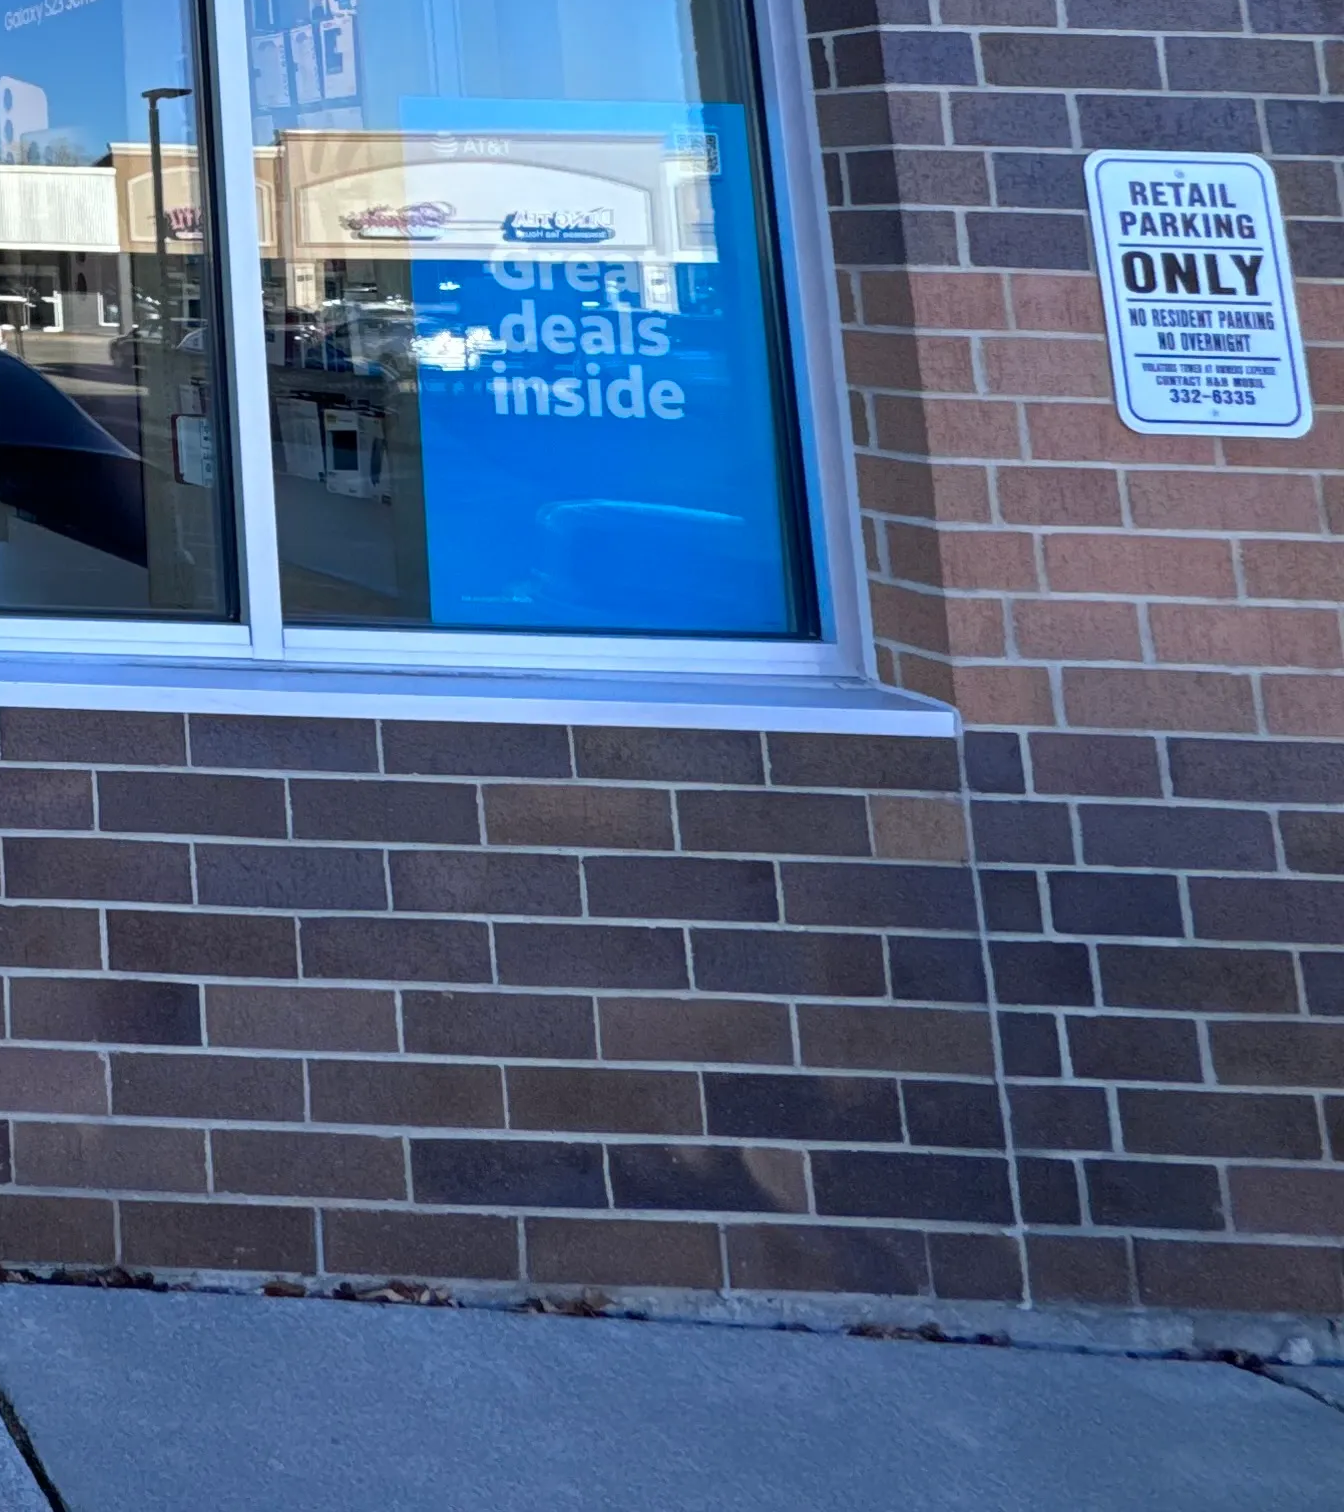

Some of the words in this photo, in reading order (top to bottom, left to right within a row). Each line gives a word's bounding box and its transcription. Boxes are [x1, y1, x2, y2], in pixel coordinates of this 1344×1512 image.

[4, 2, 44, 31] Galaxy
[1128, 180, 1237, 209] RETAIL
[1119, 211, 1257, 240] PARKING
[1121, 250, 1265, 297] ONLY
[499, 298, 671, 357] deals
[1128, 307, 1147, 327] NO
[1152, 308, 1213, 329] RESIDENT
[1218, 310, 1275, 331] PARKING
[1157, 331, 1176, 351] NO
[1181, 332, 1252, 353] OVERNIGHT
[491, 359, 686, 420] inside
[1155, 375, 1201, 387] CONTACT
[1169, 388, 1257, 406] 332-6335
